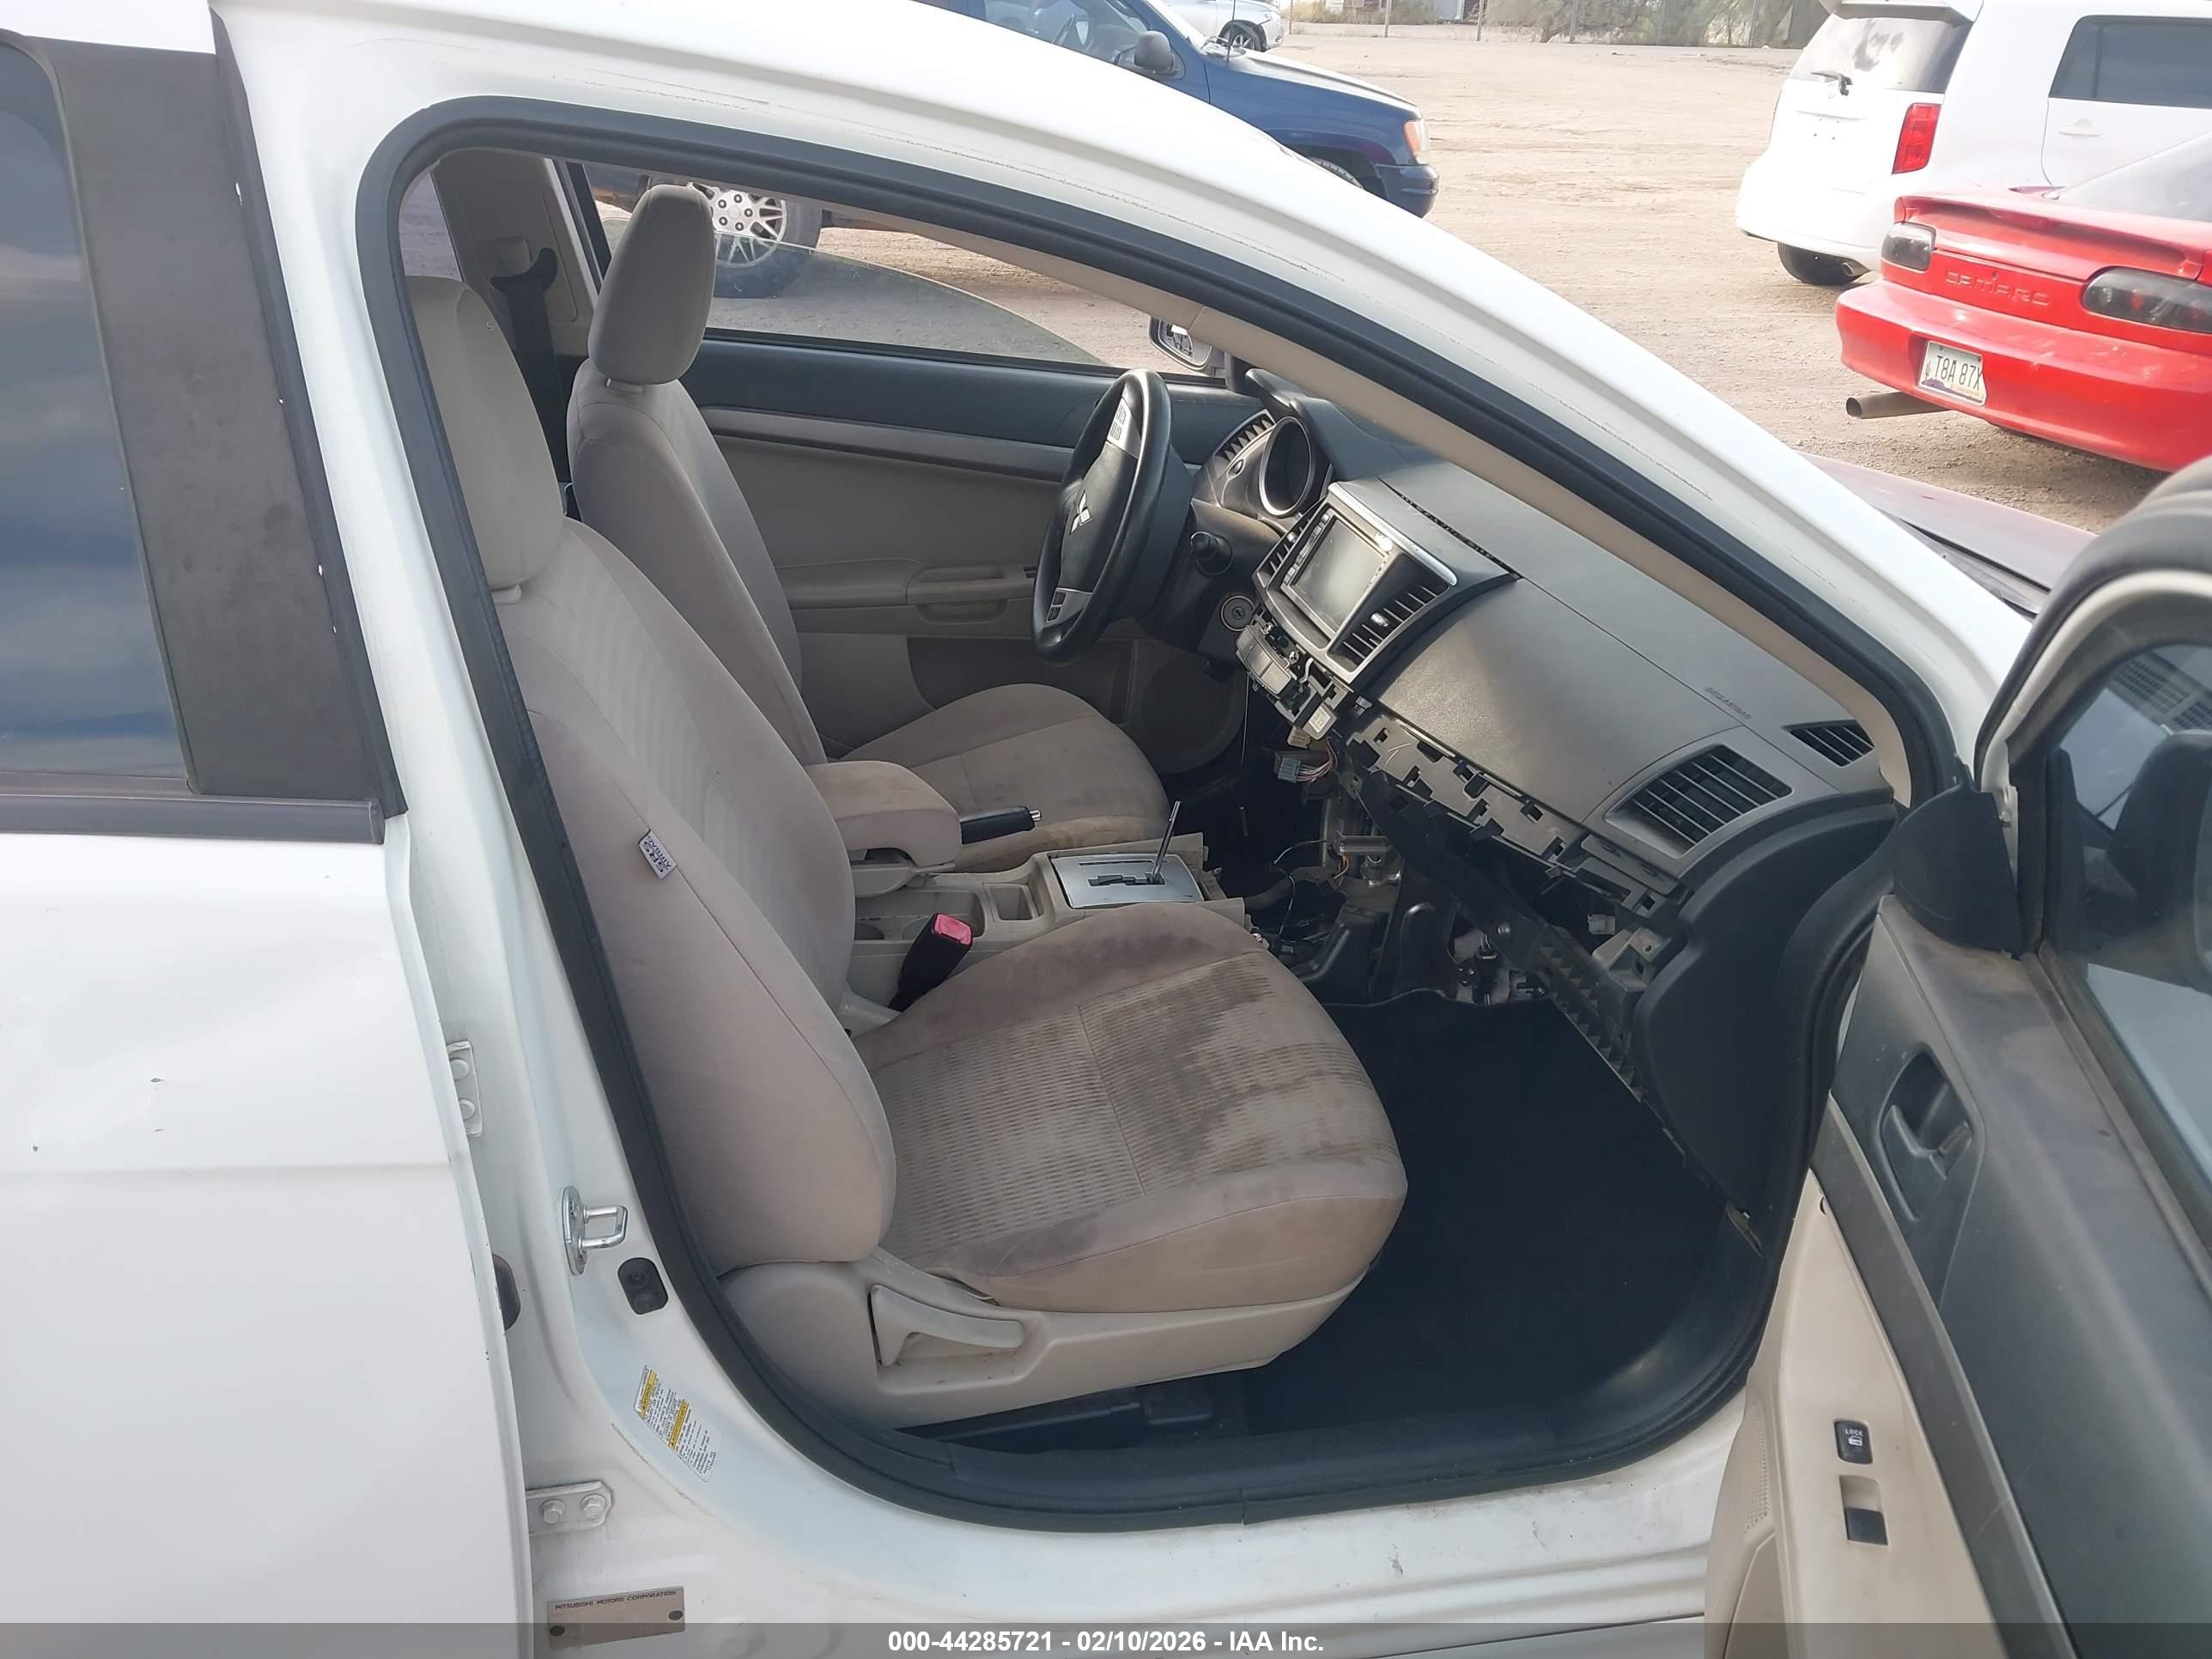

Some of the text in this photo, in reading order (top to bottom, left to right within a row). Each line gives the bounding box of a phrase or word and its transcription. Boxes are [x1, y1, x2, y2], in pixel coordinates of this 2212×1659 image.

[1945, 270, 2050, 306] CAMARO
[642, 842, 664, 872] SRS
[647, 836, 672, 867] AIRBAG
[555, 1601, 593, 1610] MITSUBISHI
[627, 1590, 677, 1601] CORPORATION
